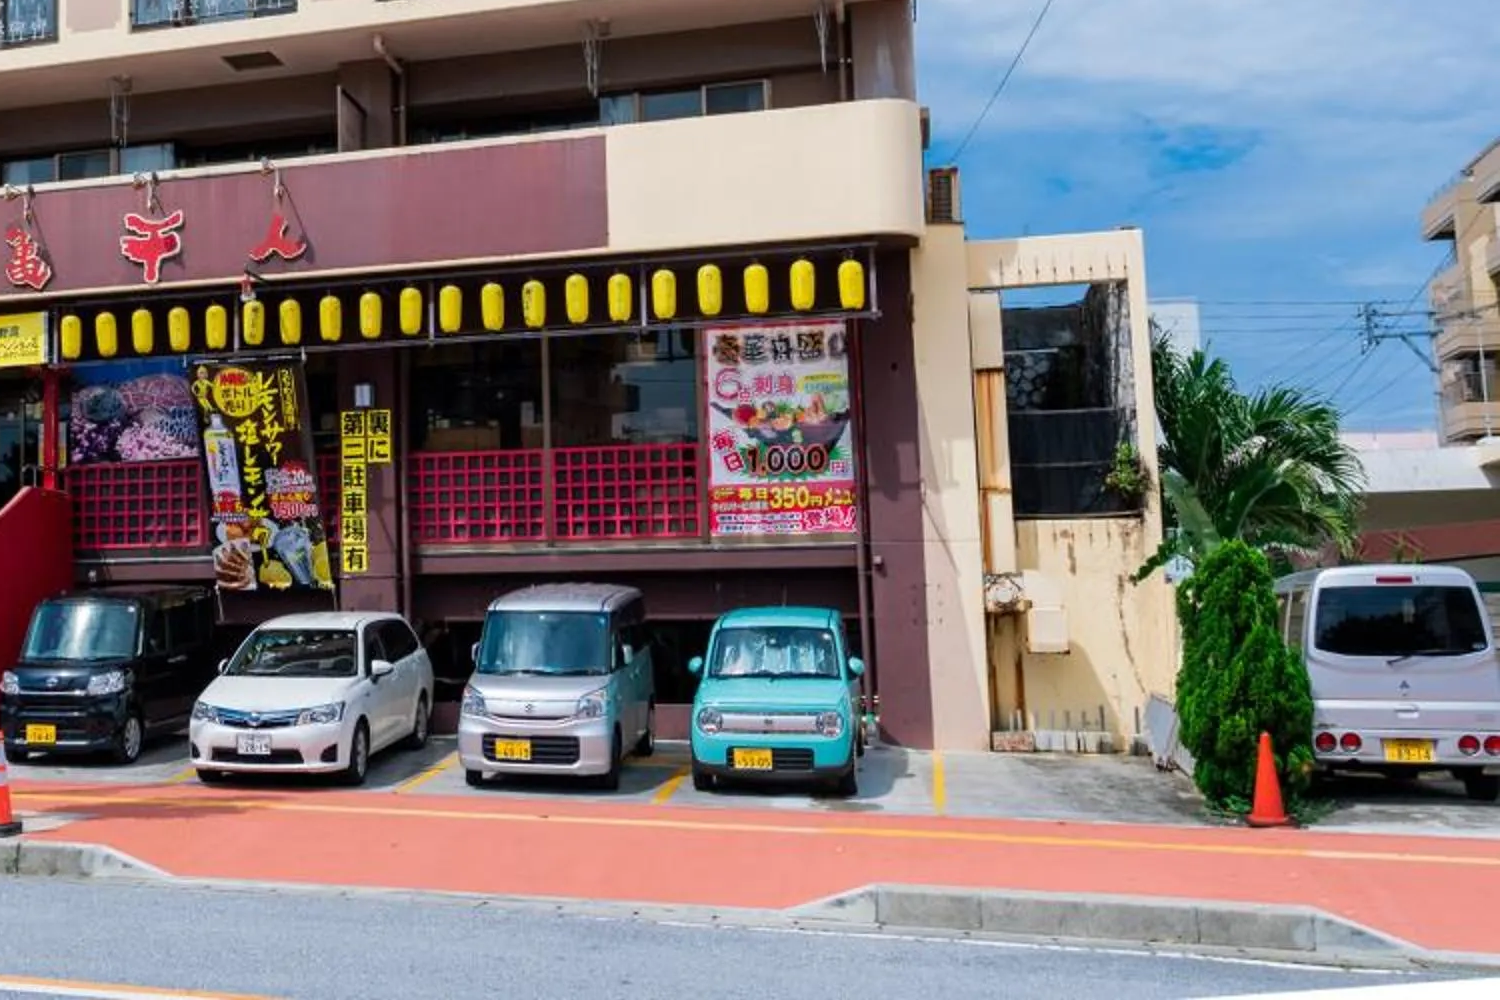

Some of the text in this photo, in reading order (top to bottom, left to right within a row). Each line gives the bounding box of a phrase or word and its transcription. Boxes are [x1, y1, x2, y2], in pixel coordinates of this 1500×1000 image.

[342, 413, 365, 570] 第二駐車場有
